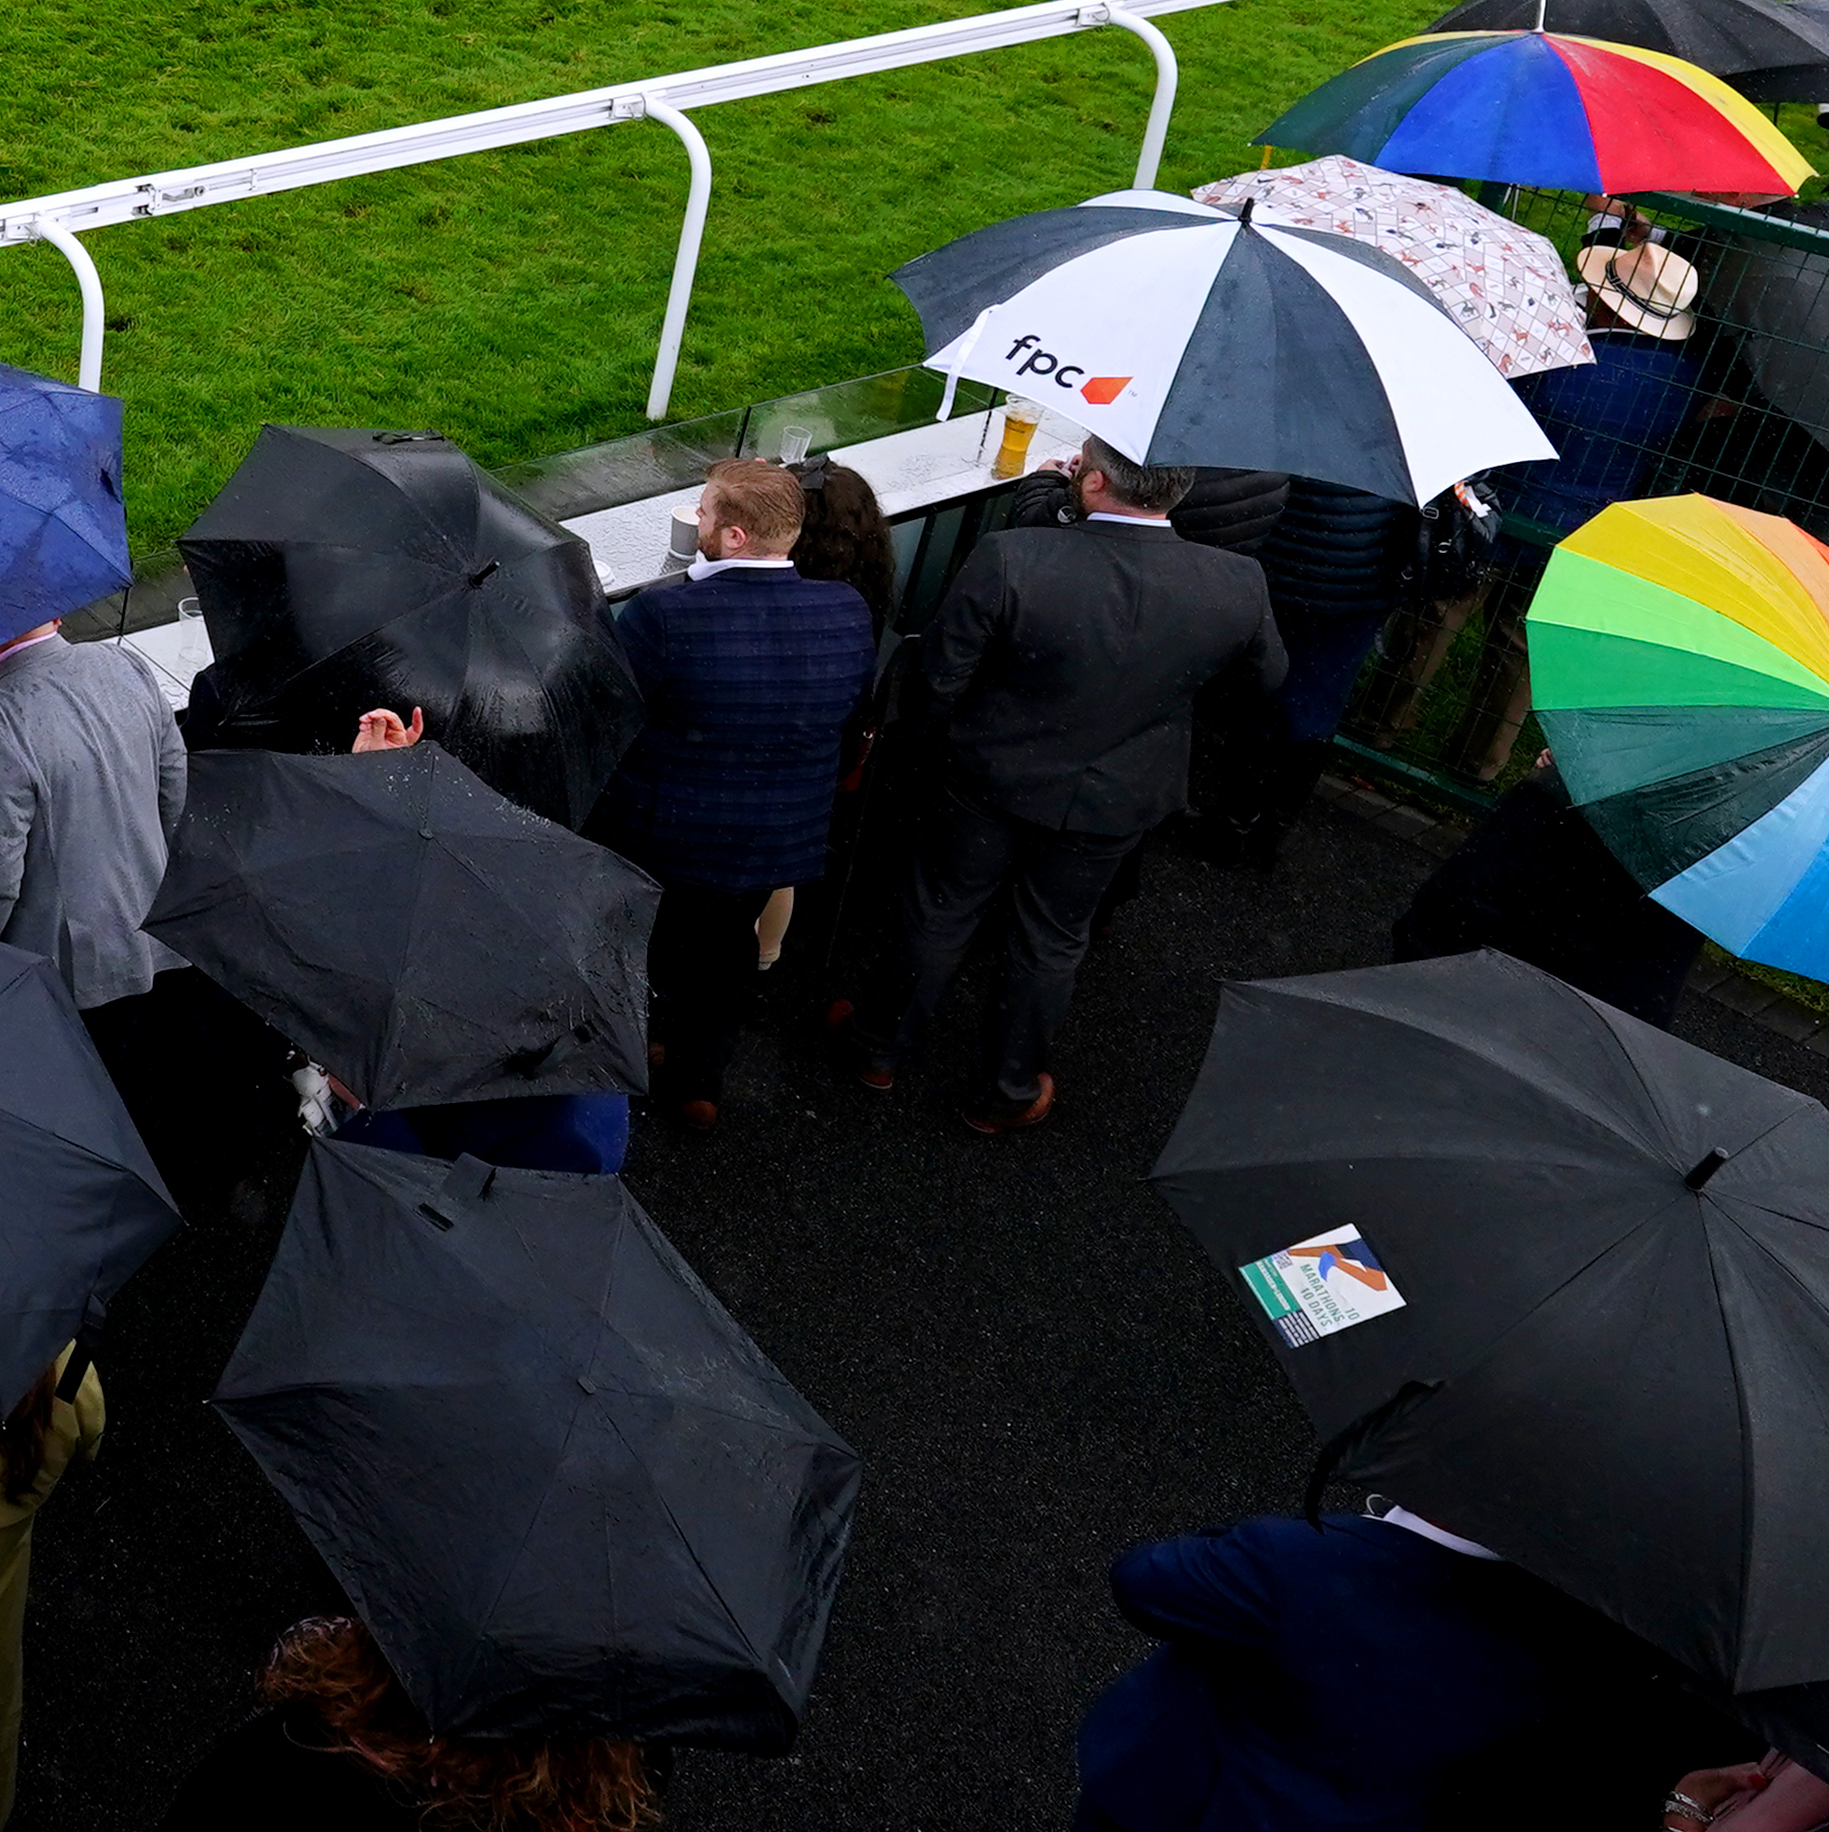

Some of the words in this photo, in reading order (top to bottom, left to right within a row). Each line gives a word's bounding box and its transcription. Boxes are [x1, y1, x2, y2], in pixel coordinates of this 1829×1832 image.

[1005, 334, 1086, 389] fpc
[1301, 1287, 1314, 1301] 10
[1344, 1306, 1361, 1322] 10
